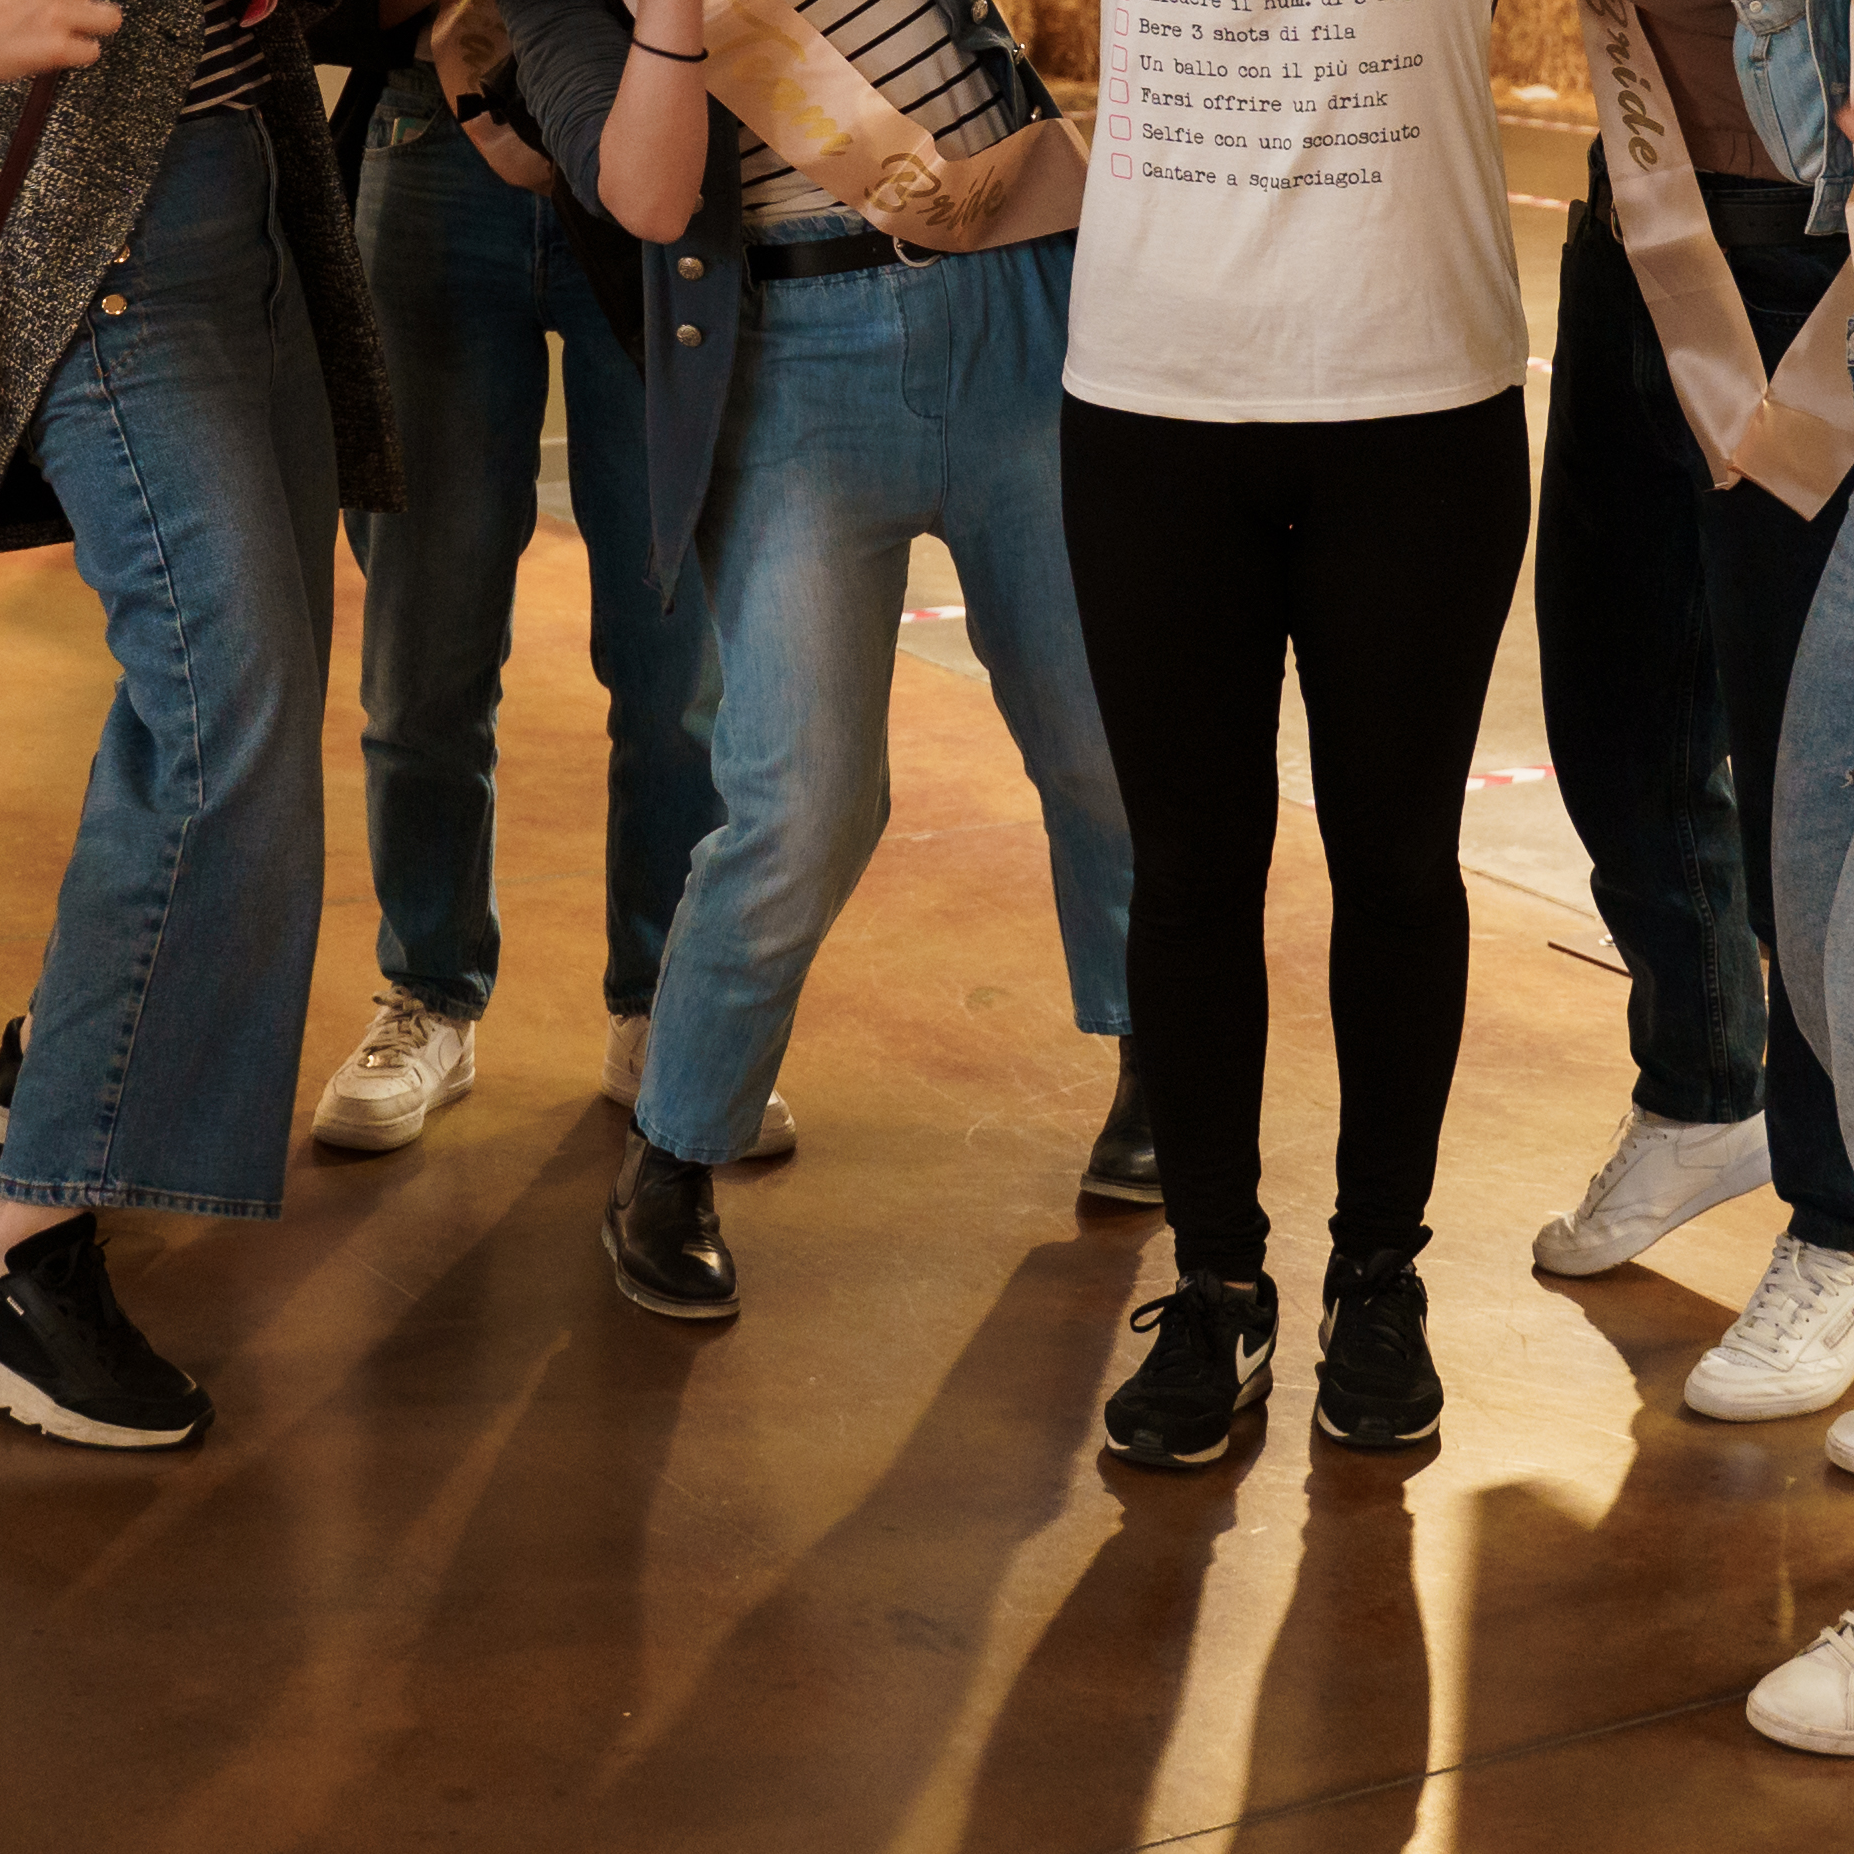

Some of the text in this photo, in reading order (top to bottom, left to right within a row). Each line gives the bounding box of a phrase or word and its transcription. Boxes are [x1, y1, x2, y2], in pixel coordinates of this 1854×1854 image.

[1138, 17, 1357, 42] Bere 3 shots di fila
[1139, 53, 1424, 82] Un ballo con il più carino
[1140, 87, 1388, 113] Farsi offrire un drink
[1142, 123, 1421, 151] Selfie con uno sconosciuto
[864, 152, 1005, 231] Bride
[1142, 162, 1382, 193] Cantare a squarciagola
